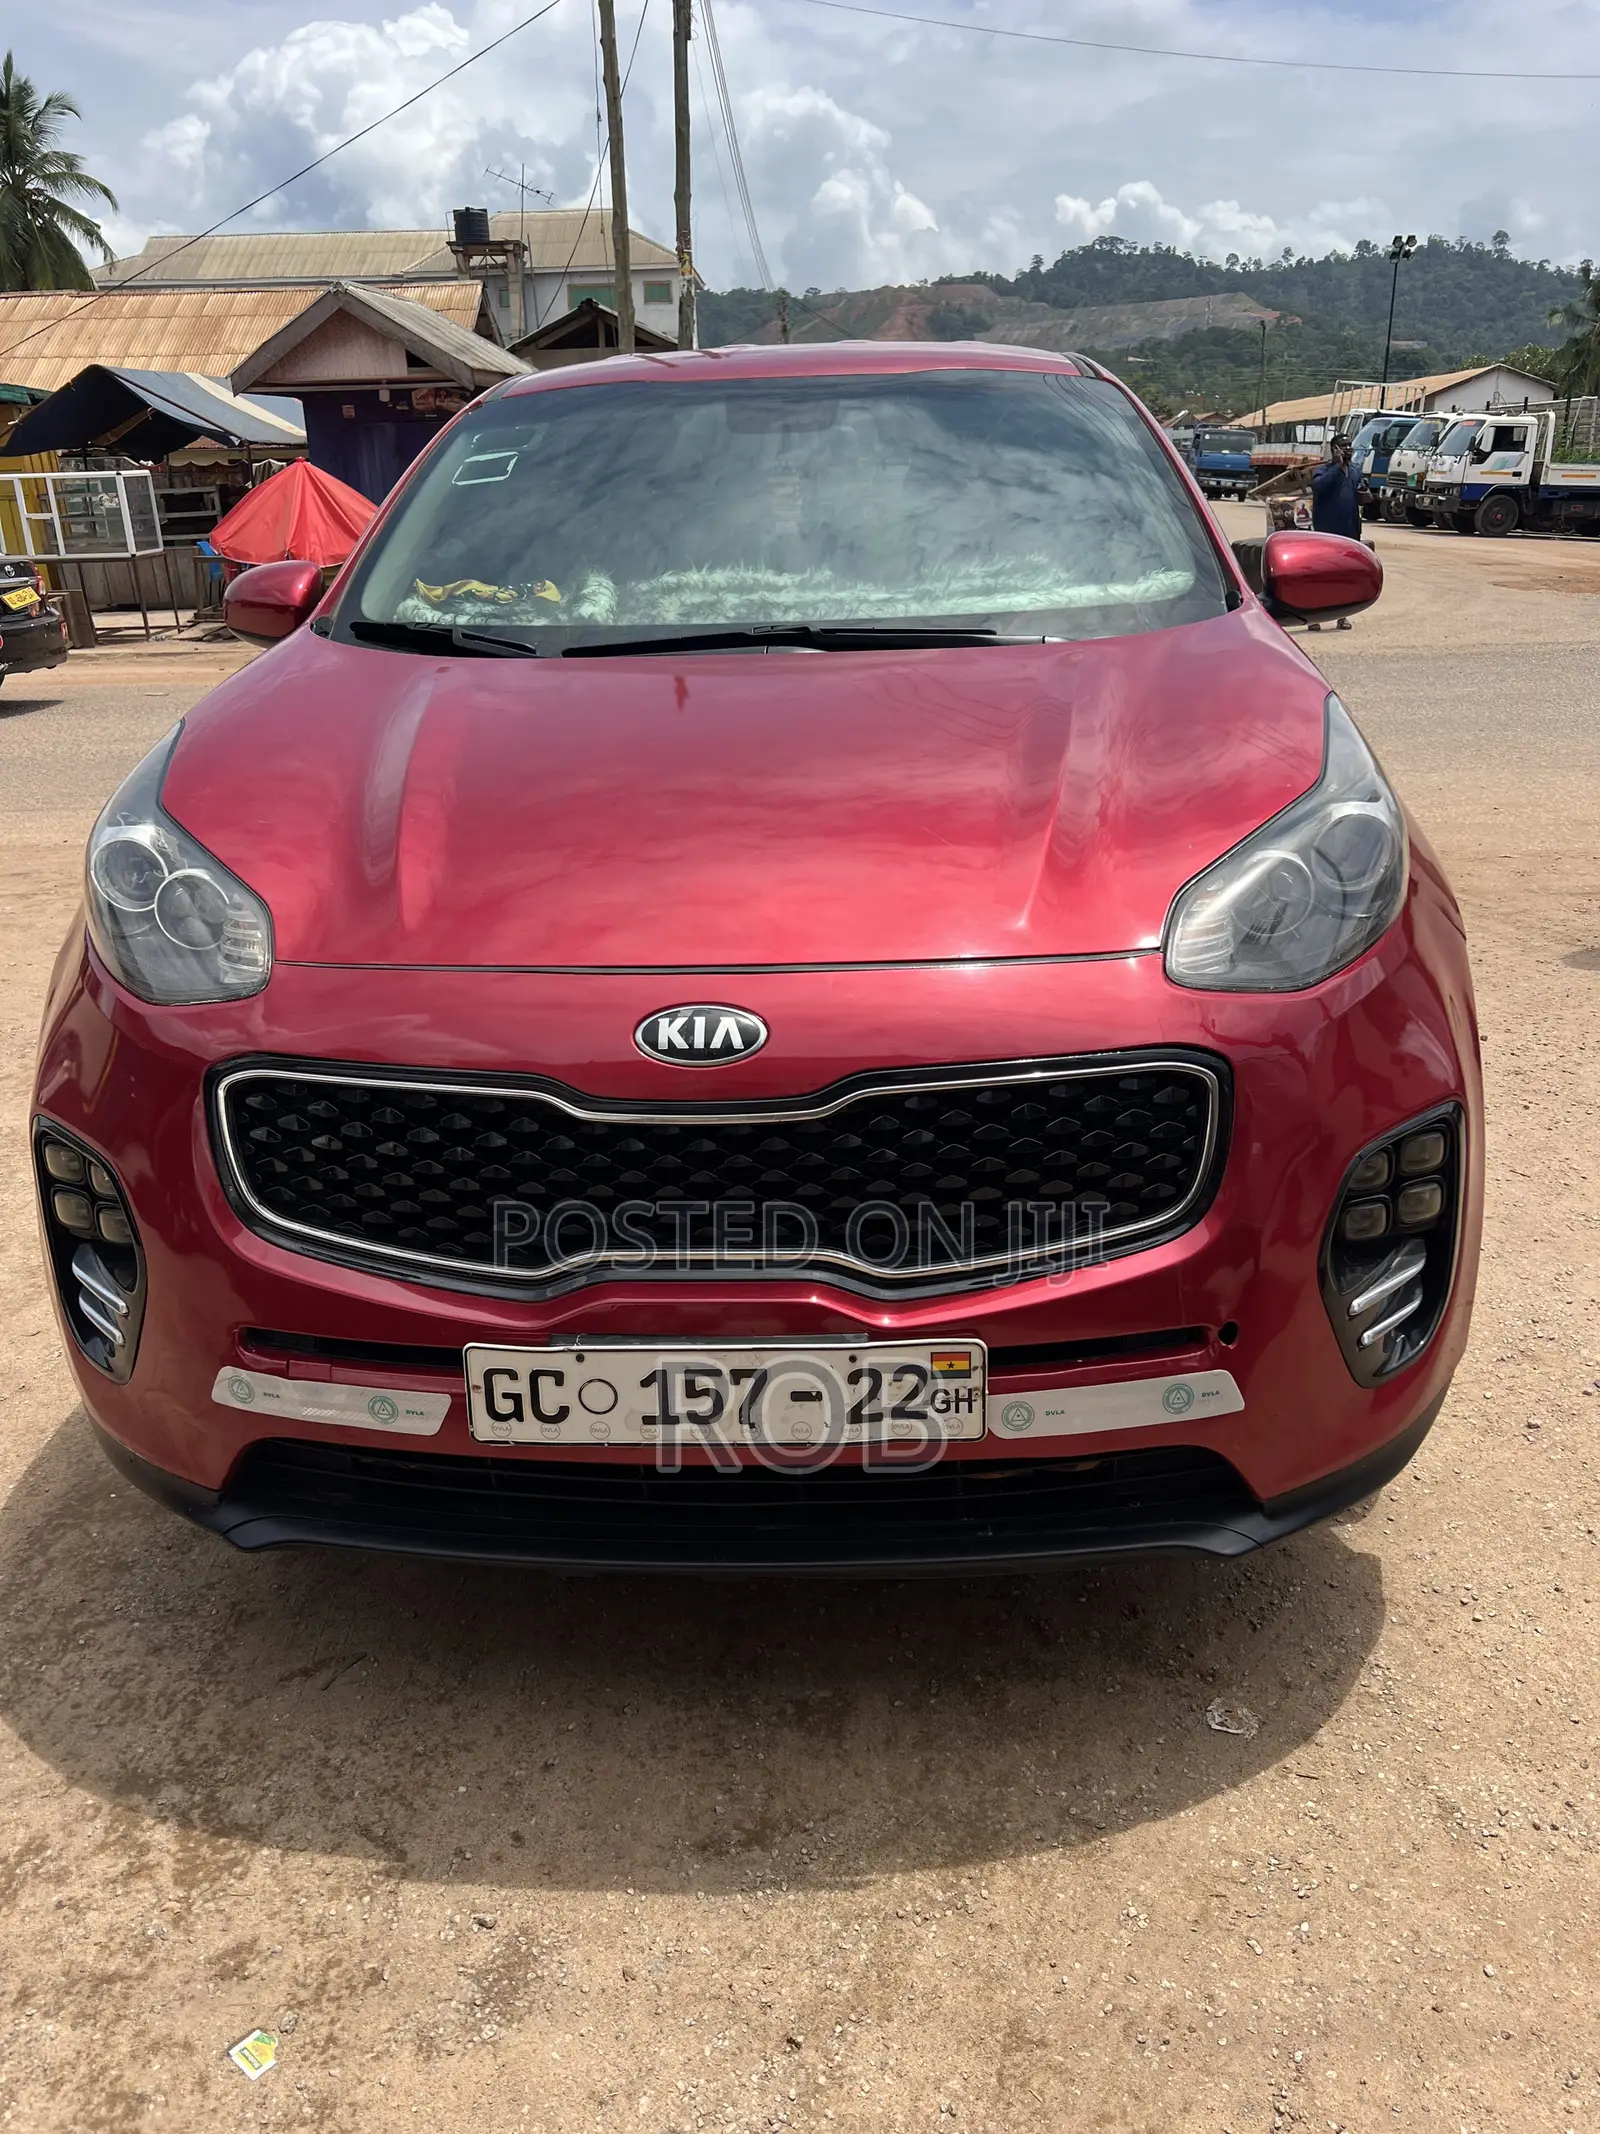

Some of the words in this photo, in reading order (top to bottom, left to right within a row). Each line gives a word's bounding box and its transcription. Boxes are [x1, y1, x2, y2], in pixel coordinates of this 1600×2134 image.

[657, 1016, 745, 1050] KIA
[482, 1366, 571, 1425] GC
[639, 1367, 768, 1426] 157
[846, 1363, 929, 1425] 22
[930, 1387, 974, 1415] GH
[1201, 1390, 1220, 1398] DVLA
[1045, 1409, 1066, 1417] DVLA
